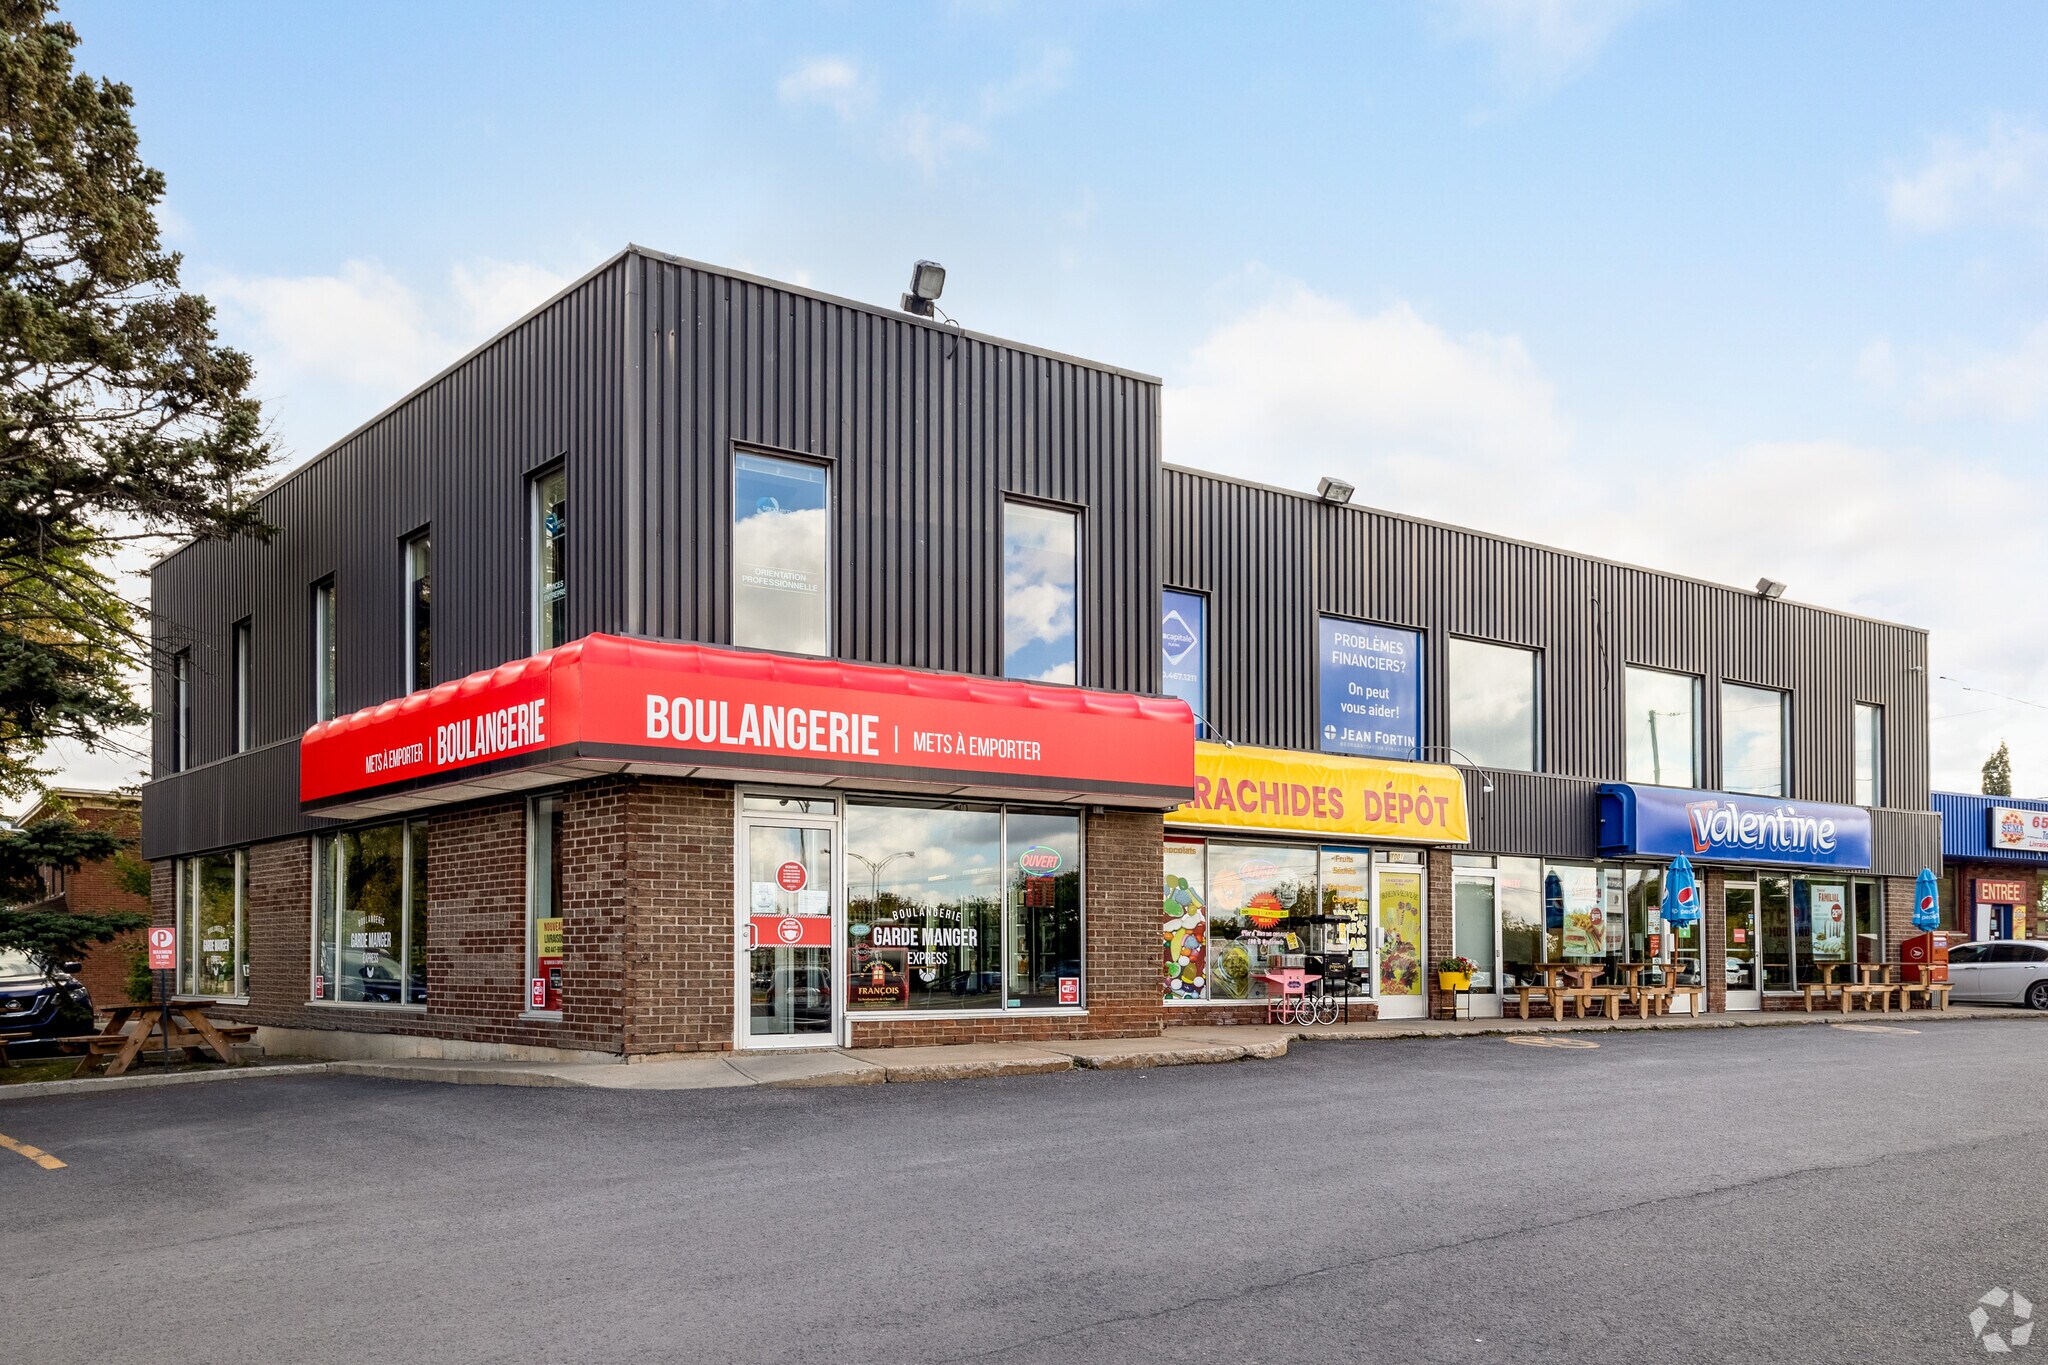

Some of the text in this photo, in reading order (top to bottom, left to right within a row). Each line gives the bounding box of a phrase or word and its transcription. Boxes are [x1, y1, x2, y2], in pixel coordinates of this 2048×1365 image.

[755, 567, 806, 581] ORIENTATION
[742, 575, 818, 592] PROFESSIONNELLE
[1334, 632, 1404, 655] PROBLÈMES
[1332, 650, 1406, 673] FINANCIERS?
[1348, 682, 1390, 700] On peut
[1340, 702, 1400, 719] vous aider!
[365, 698, 545, 774] METS À EMPORTER BOULANGERIE
[646, 694, 1041, 762] BOULANGERIE METS À EMPORTER
[1340, 727, 1415, 747] JEAN FORTIN
[1177, 776, 1449, 828] RACHIDES DÉPÔT
[1690, 801, 1836, 852] Valentine
[2001, 823, 2024, 834] SEMA
[1022, 853, 1059, 869] OUVERT
[1335, 855, 1354, 864] Fruits
[1381, 889, 1419, 901] BIENVENUE
[1982, 881, 2020, 901] ENTRÉE
[892, 907, 962, 922] BOULANGERIE
[351, 932, 392, 948] GARDE MANGER
[873, 926, 919, 946] GARDE
[921, 927, 978, 947] MANGER
[852, 948, 872, 956] UNION
[907, 951, 948, 965] EXPRESS
[858, 986, 899, 996] FRANÇOIS
